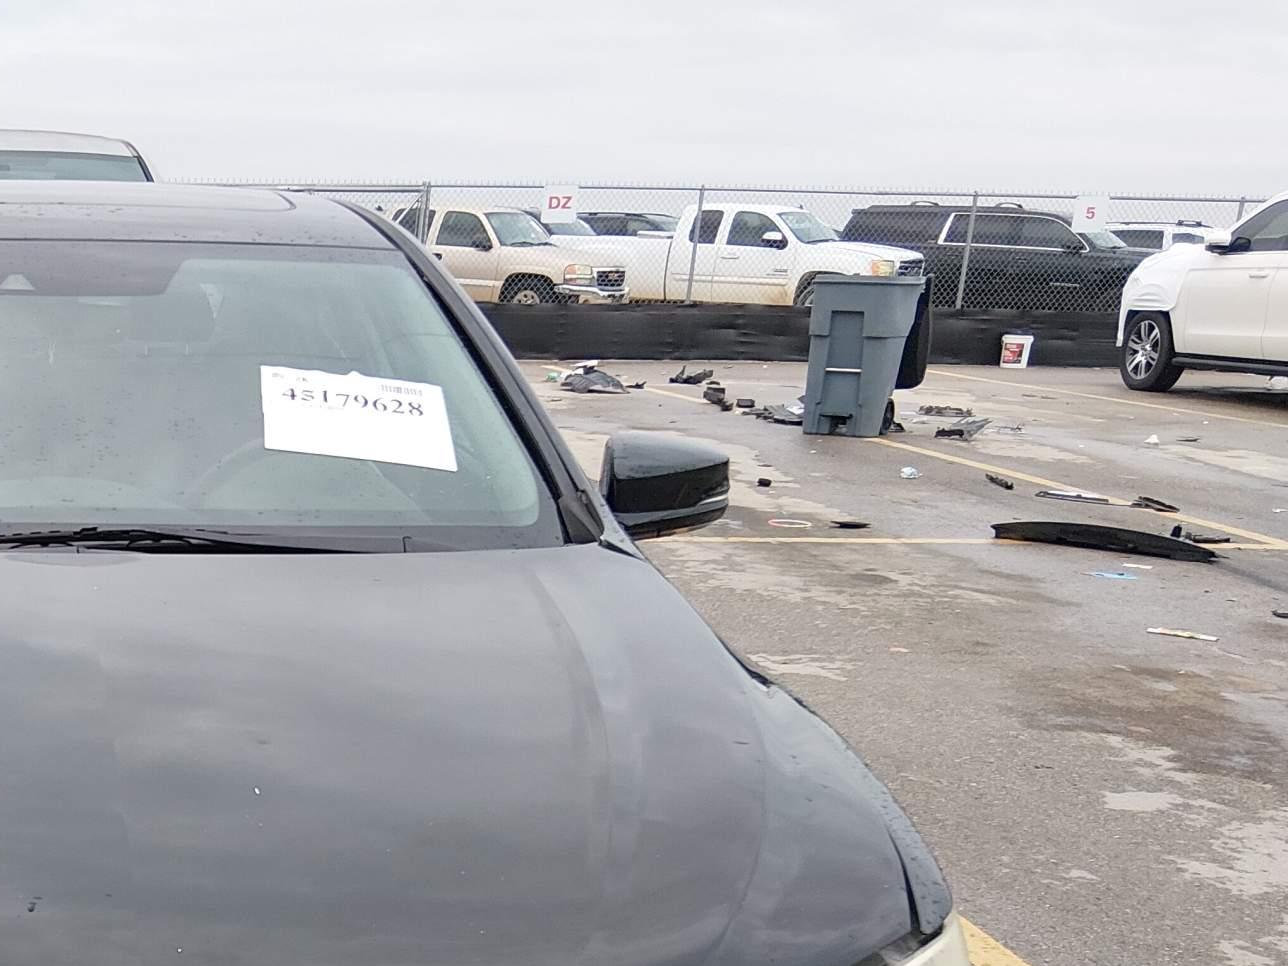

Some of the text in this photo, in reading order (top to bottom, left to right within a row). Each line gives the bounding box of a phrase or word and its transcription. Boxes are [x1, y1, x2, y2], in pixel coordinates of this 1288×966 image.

[547, 195, 573, 210] DZ
[1085, 206, 1097, 220] 5
[281, 387, 425, 417] 45179628
